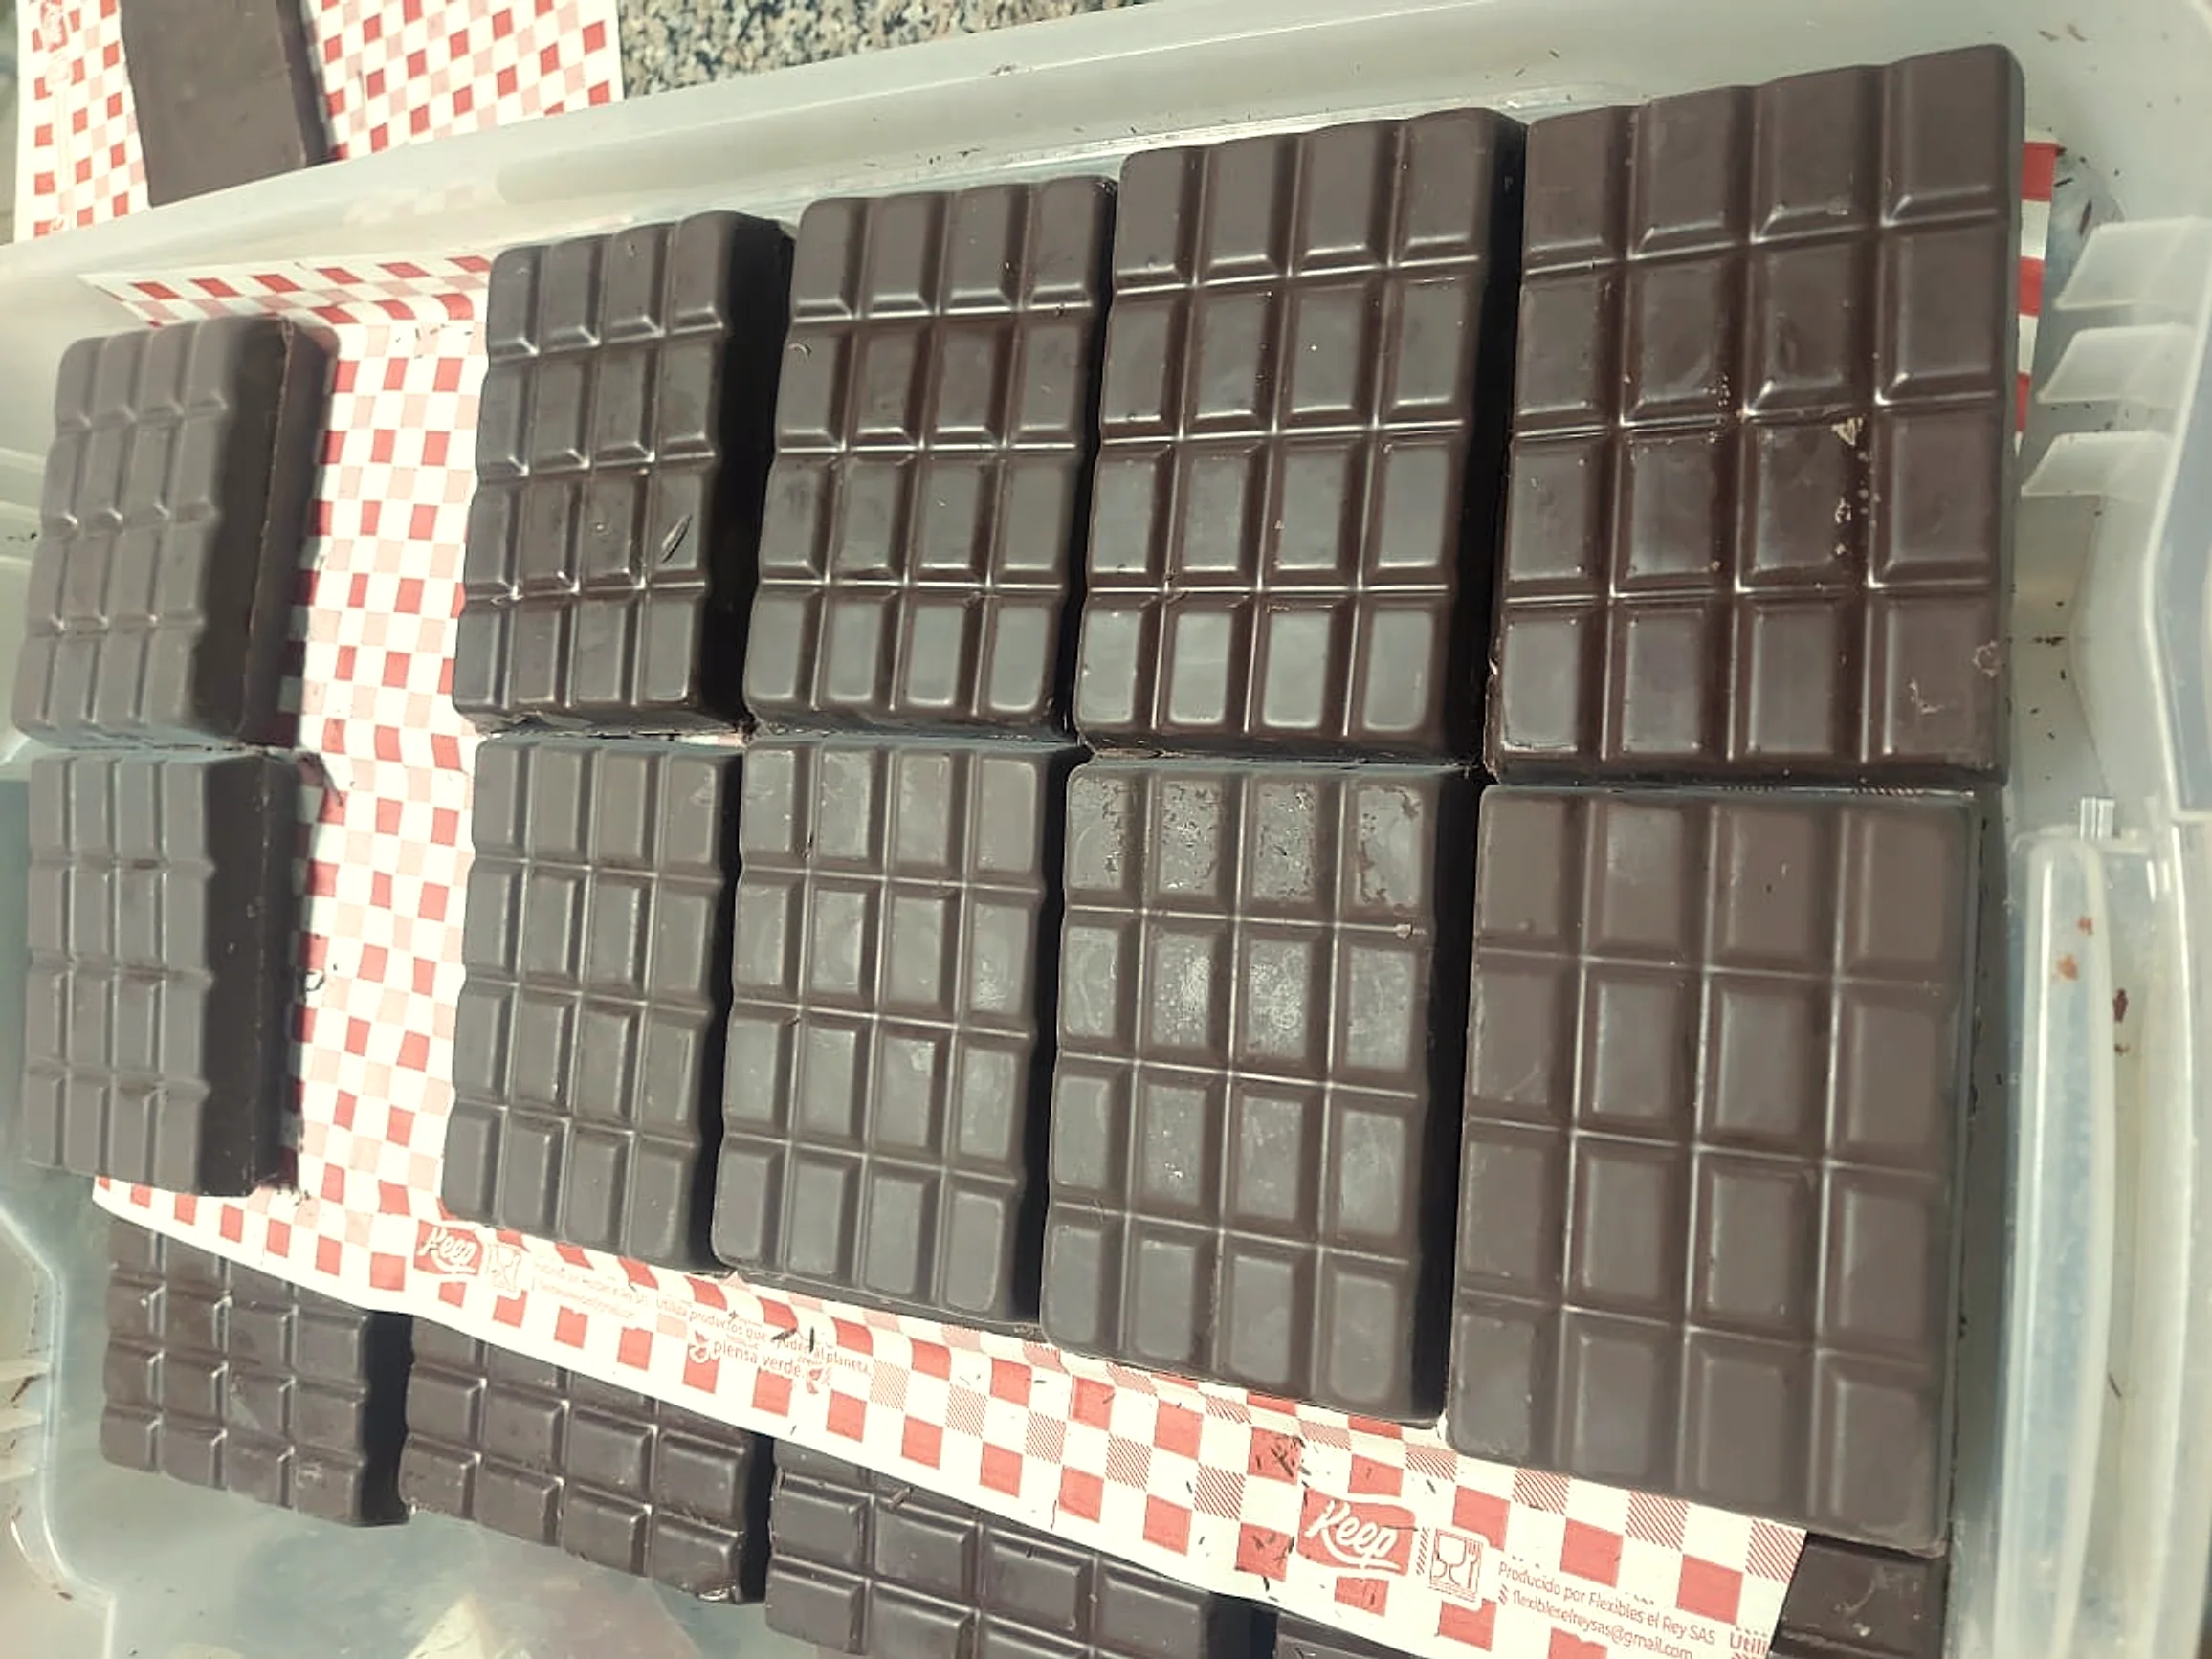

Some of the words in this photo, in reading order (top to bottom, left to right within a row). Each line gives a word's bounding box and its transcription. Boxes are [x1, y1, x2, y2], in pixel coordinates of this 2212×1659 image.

[417, 1227, 477, 1277] Keep
[689, 1310, 743, 1335] productos
[746, 1327, 767, 1341] que
[714, 1340, 758, 1363] piensa
[1304, 1499, 1404, 1570] Keep
[1499, 1561, 1560, 1595] Producido
[1564, 1587, 1585, 1604] por
[1589, 1592, 1644, 1624] Flexibles
[1648, 1611, 1660, 1628] el
[1663, 1616, 1688, 1640] Rey
[1690, 1625, 1716, 1645] SAS
